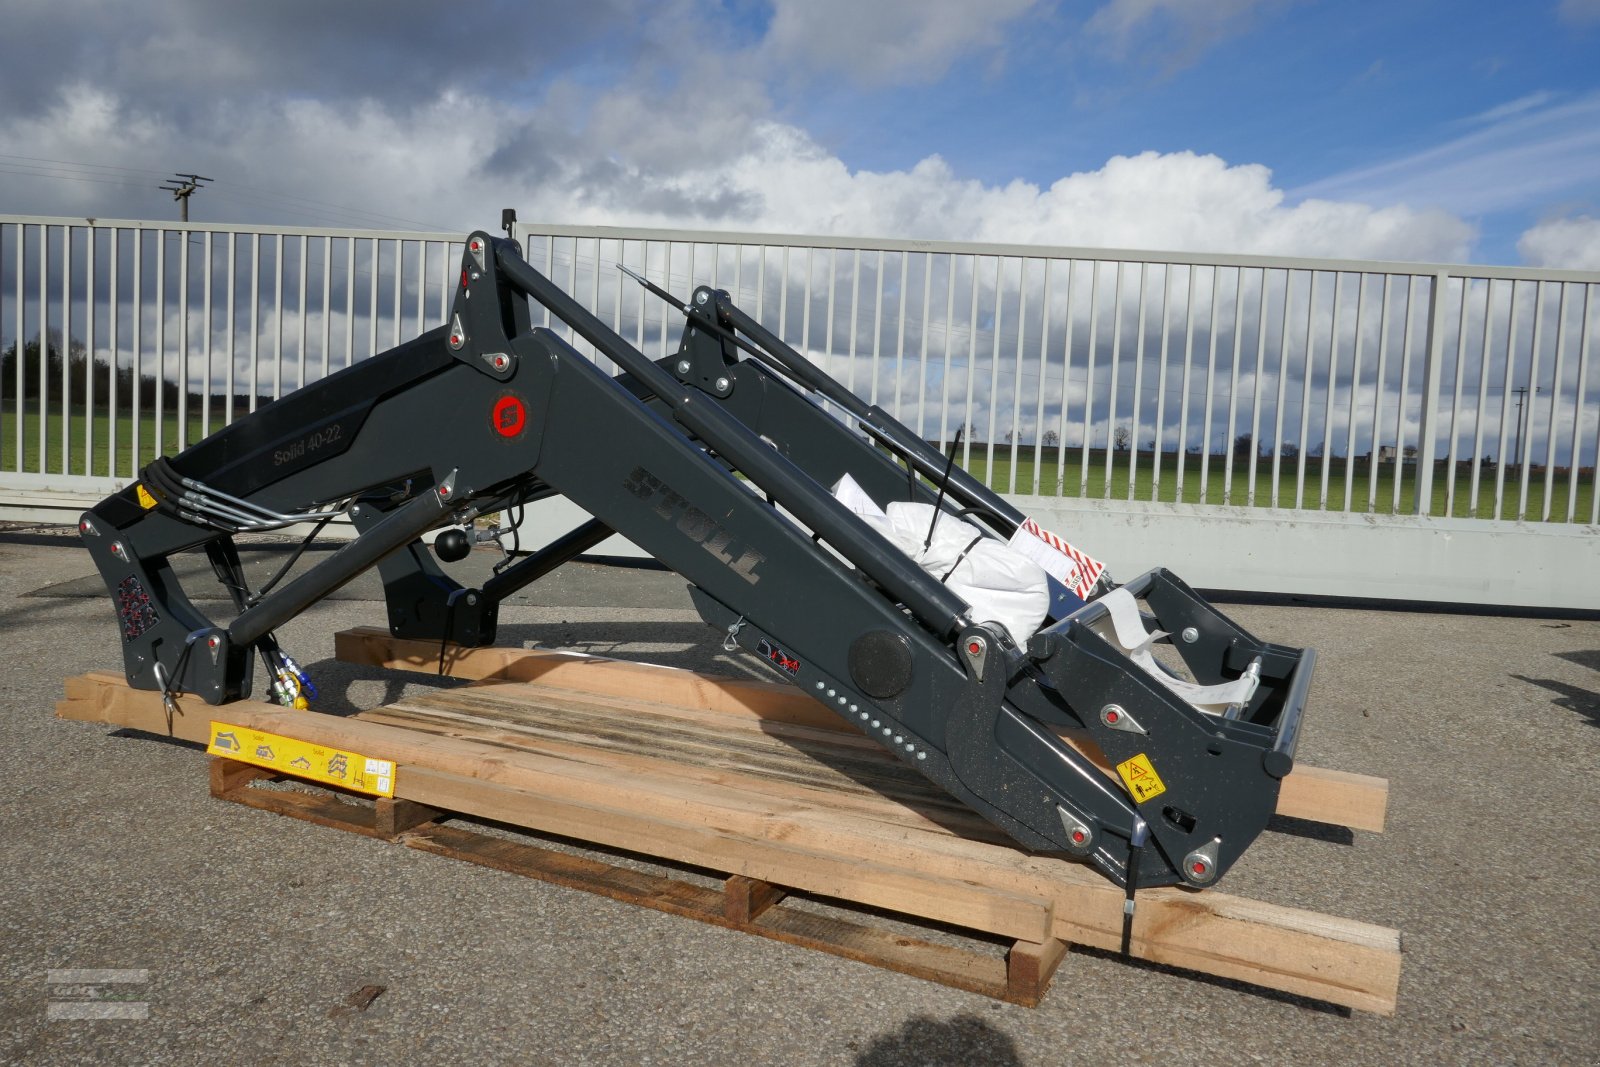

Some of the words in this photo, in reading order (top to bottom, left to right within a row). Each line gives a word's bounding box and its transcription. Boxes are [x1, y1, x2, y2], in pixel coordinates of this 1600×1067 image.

[273, 439, 305, 466] Solid
[308, 424, 341, 451] 40-22
[622, 464, 767, 585] STOLL
